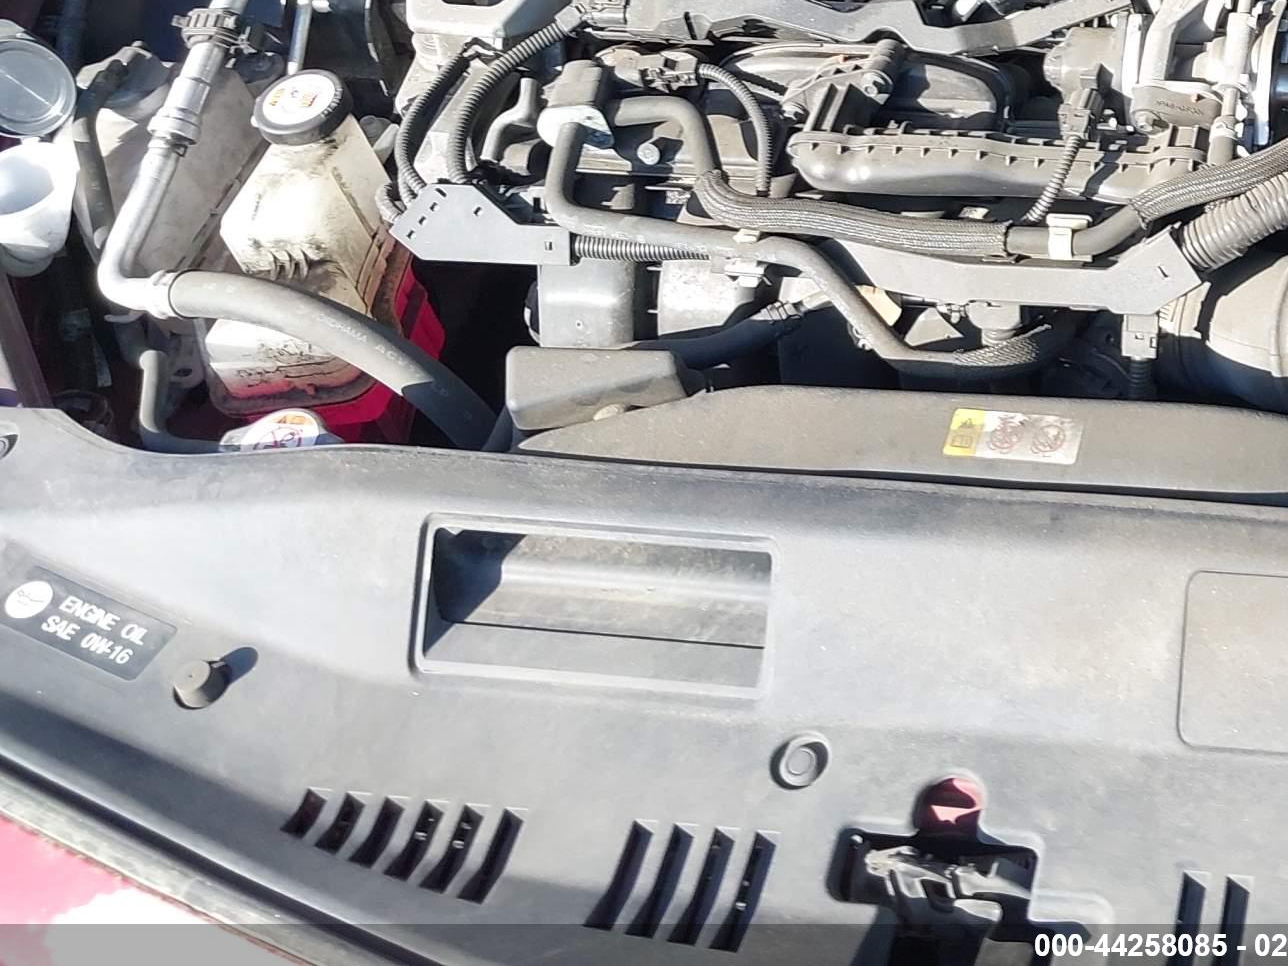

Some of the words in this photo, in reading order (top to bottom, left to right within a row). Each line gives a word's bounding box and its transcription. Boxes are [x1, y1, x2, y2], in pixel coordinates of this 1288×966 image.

[41, 615, 80, 641] SAE
[80, 632, 134, 665] 0W-16
[59, 595, 121, 632] ENGINE
[121, 623, 149, 646] OIL
